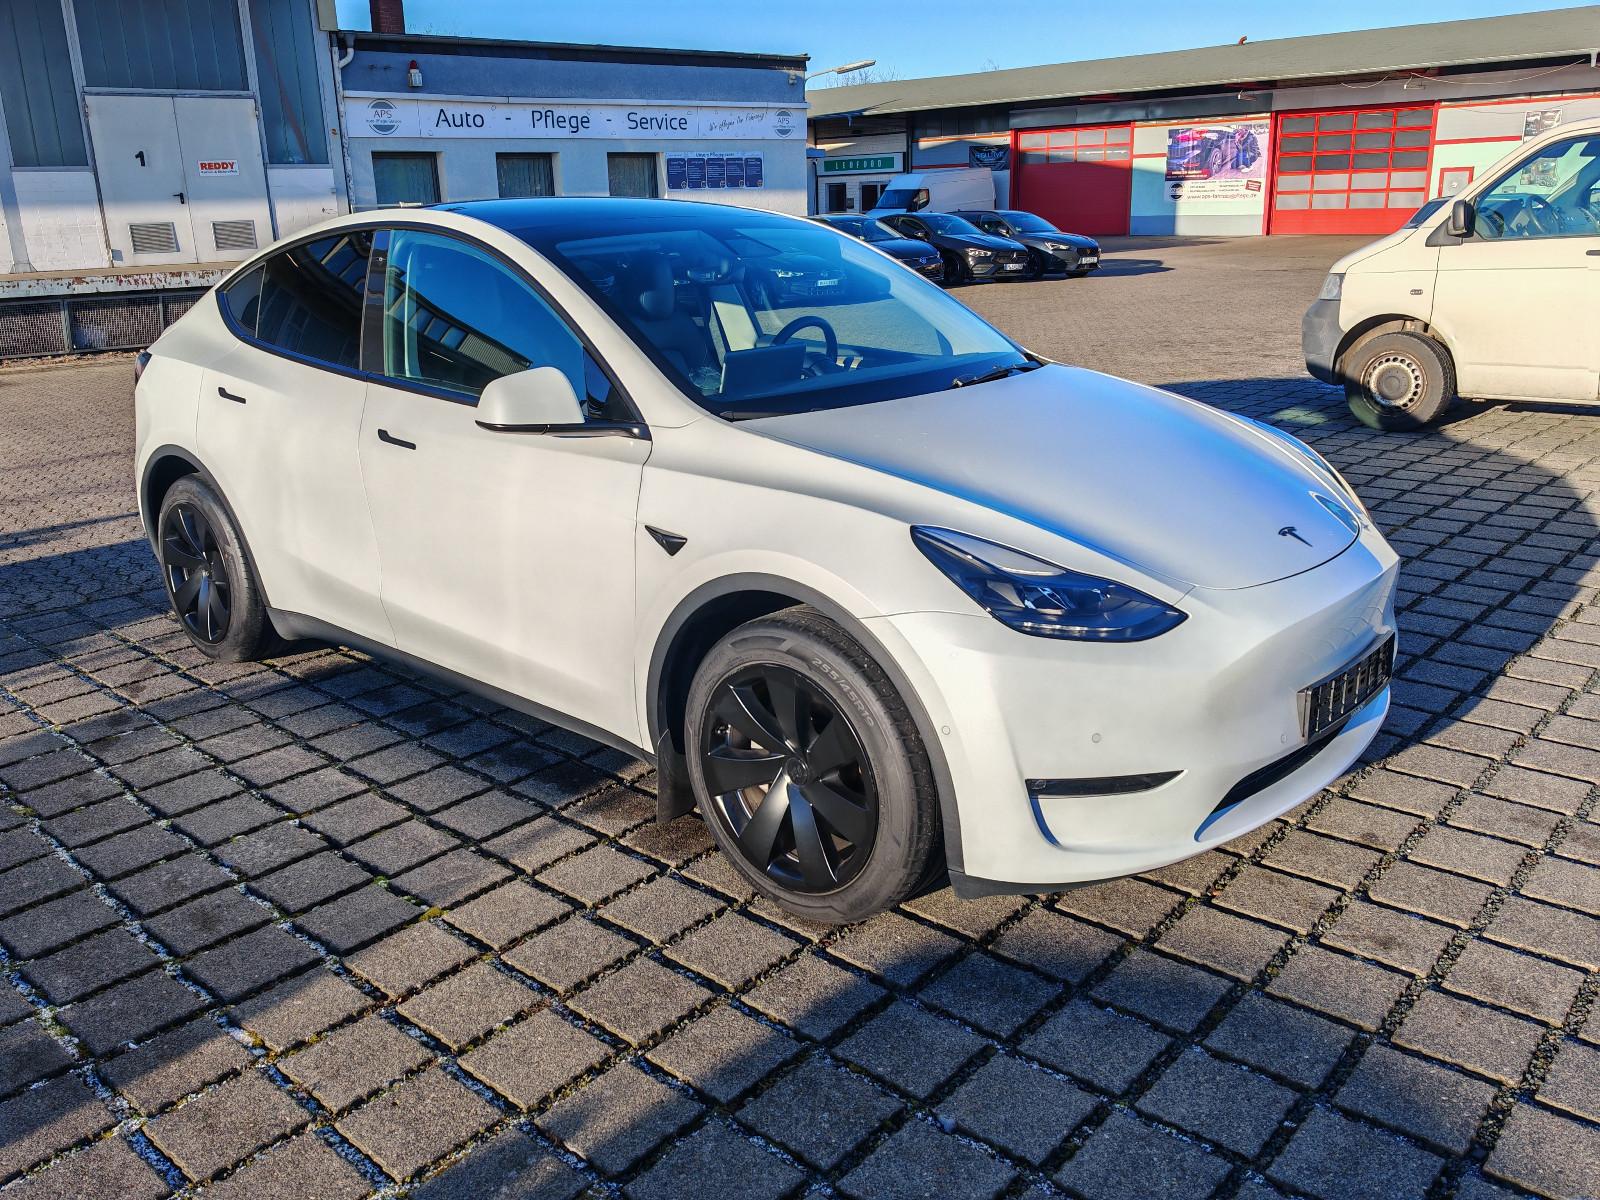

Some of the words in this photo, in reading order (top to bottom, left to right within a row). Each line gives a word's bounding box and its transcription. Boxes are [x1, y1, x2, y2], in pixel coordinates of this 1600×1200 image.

[373, 109, 393, 118] APS
[435, 108, 485, 128] Auto
[531, 110, 590, 133] Pflege
[627, 112, 688, 130] Service
[777, 117, 790, 125] APS
[135, 150, 146, 167] 1
[199, 162, 235, 170] REDDY
